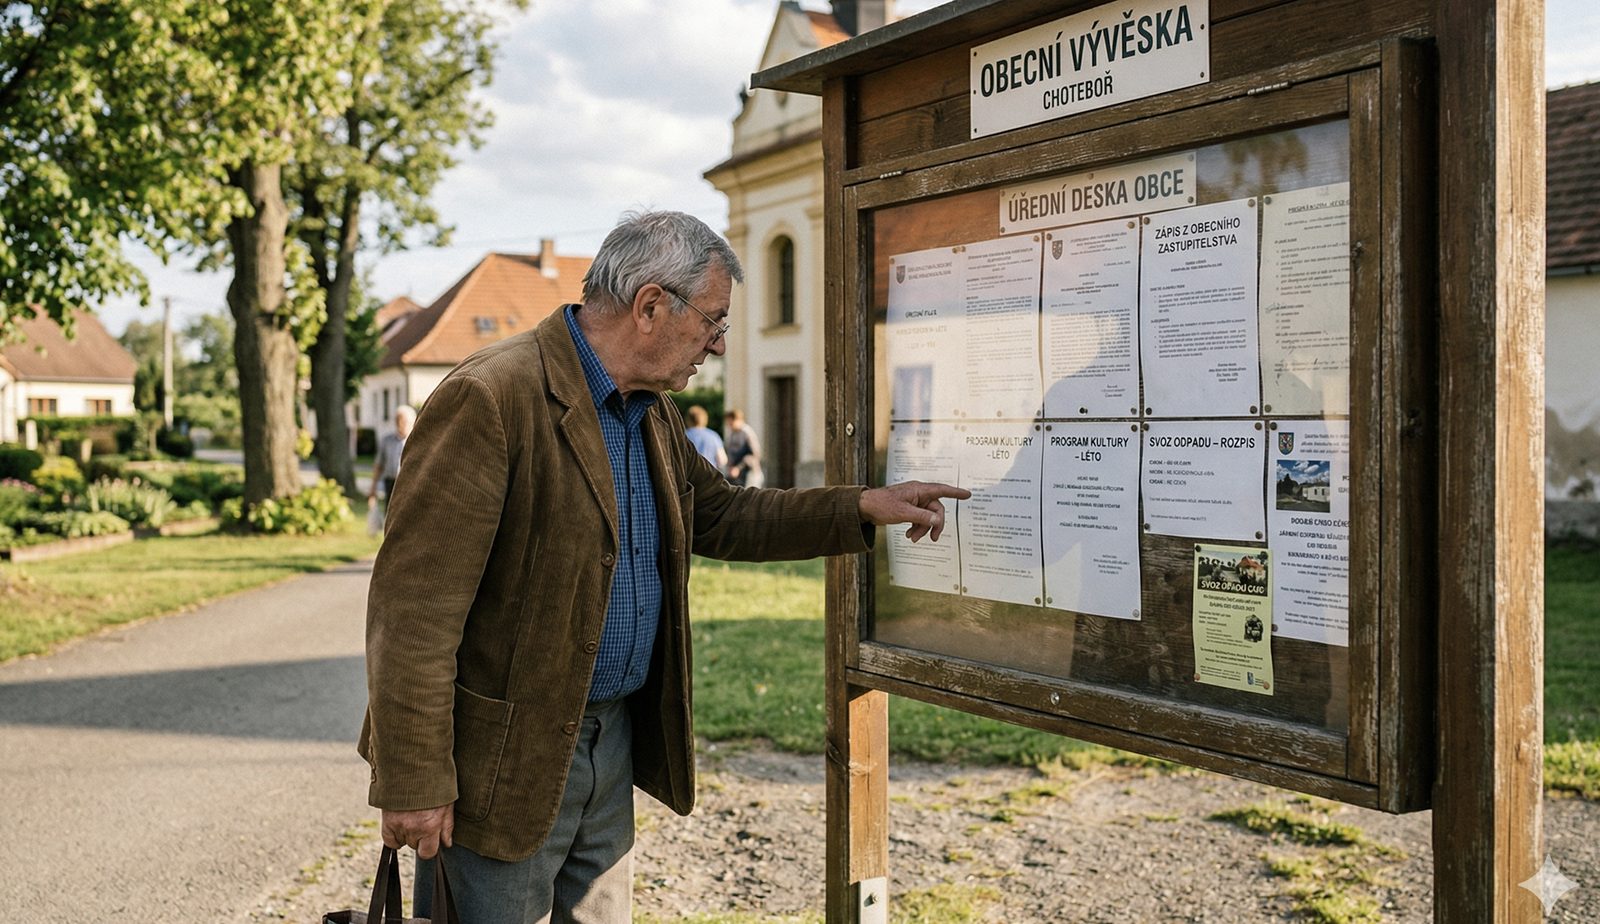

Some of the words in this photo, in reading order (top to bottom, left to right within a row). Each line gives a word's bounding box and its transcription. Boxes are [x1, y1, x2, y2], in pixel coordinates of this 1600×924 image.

[980, 31, 1063, 98] OBECNÍ
[1069, 5, 1194, 72] VÝVĚSKA
[1043, 70, 1113, 110] CHOTEBOŘ
[1008, 184, 1067, 222] ÚŘEDNÍ
[1071, 179, 1128, 212] DESKA
[1134, 169, 1184, 202] OBCE
[1155, 224, 1181, 240] ZÁPIS
[1182, 225, 1189, 236] Z
[1190, 216, 1241, 235] OBECNÍHO
[1158, 233, 1238, 254] ZASTUPITELSTVA
[966, 436, 999, 447] PROGRAM
[999, 436, 1033, 447] KULTURY
[1050, 436, 1089, 447] PROGRAM
[1090, 436, 1129, 448] KULTURY
[1149, 437, 1172, 448] SVOZ
[1173, 437, 1211, 448] ODPADU
[1220, 437, 1255, 449] ROZPIS
[992, 449, 1010, 460] LÉTO
[1080, 450, 1102, 462] LÉTO
